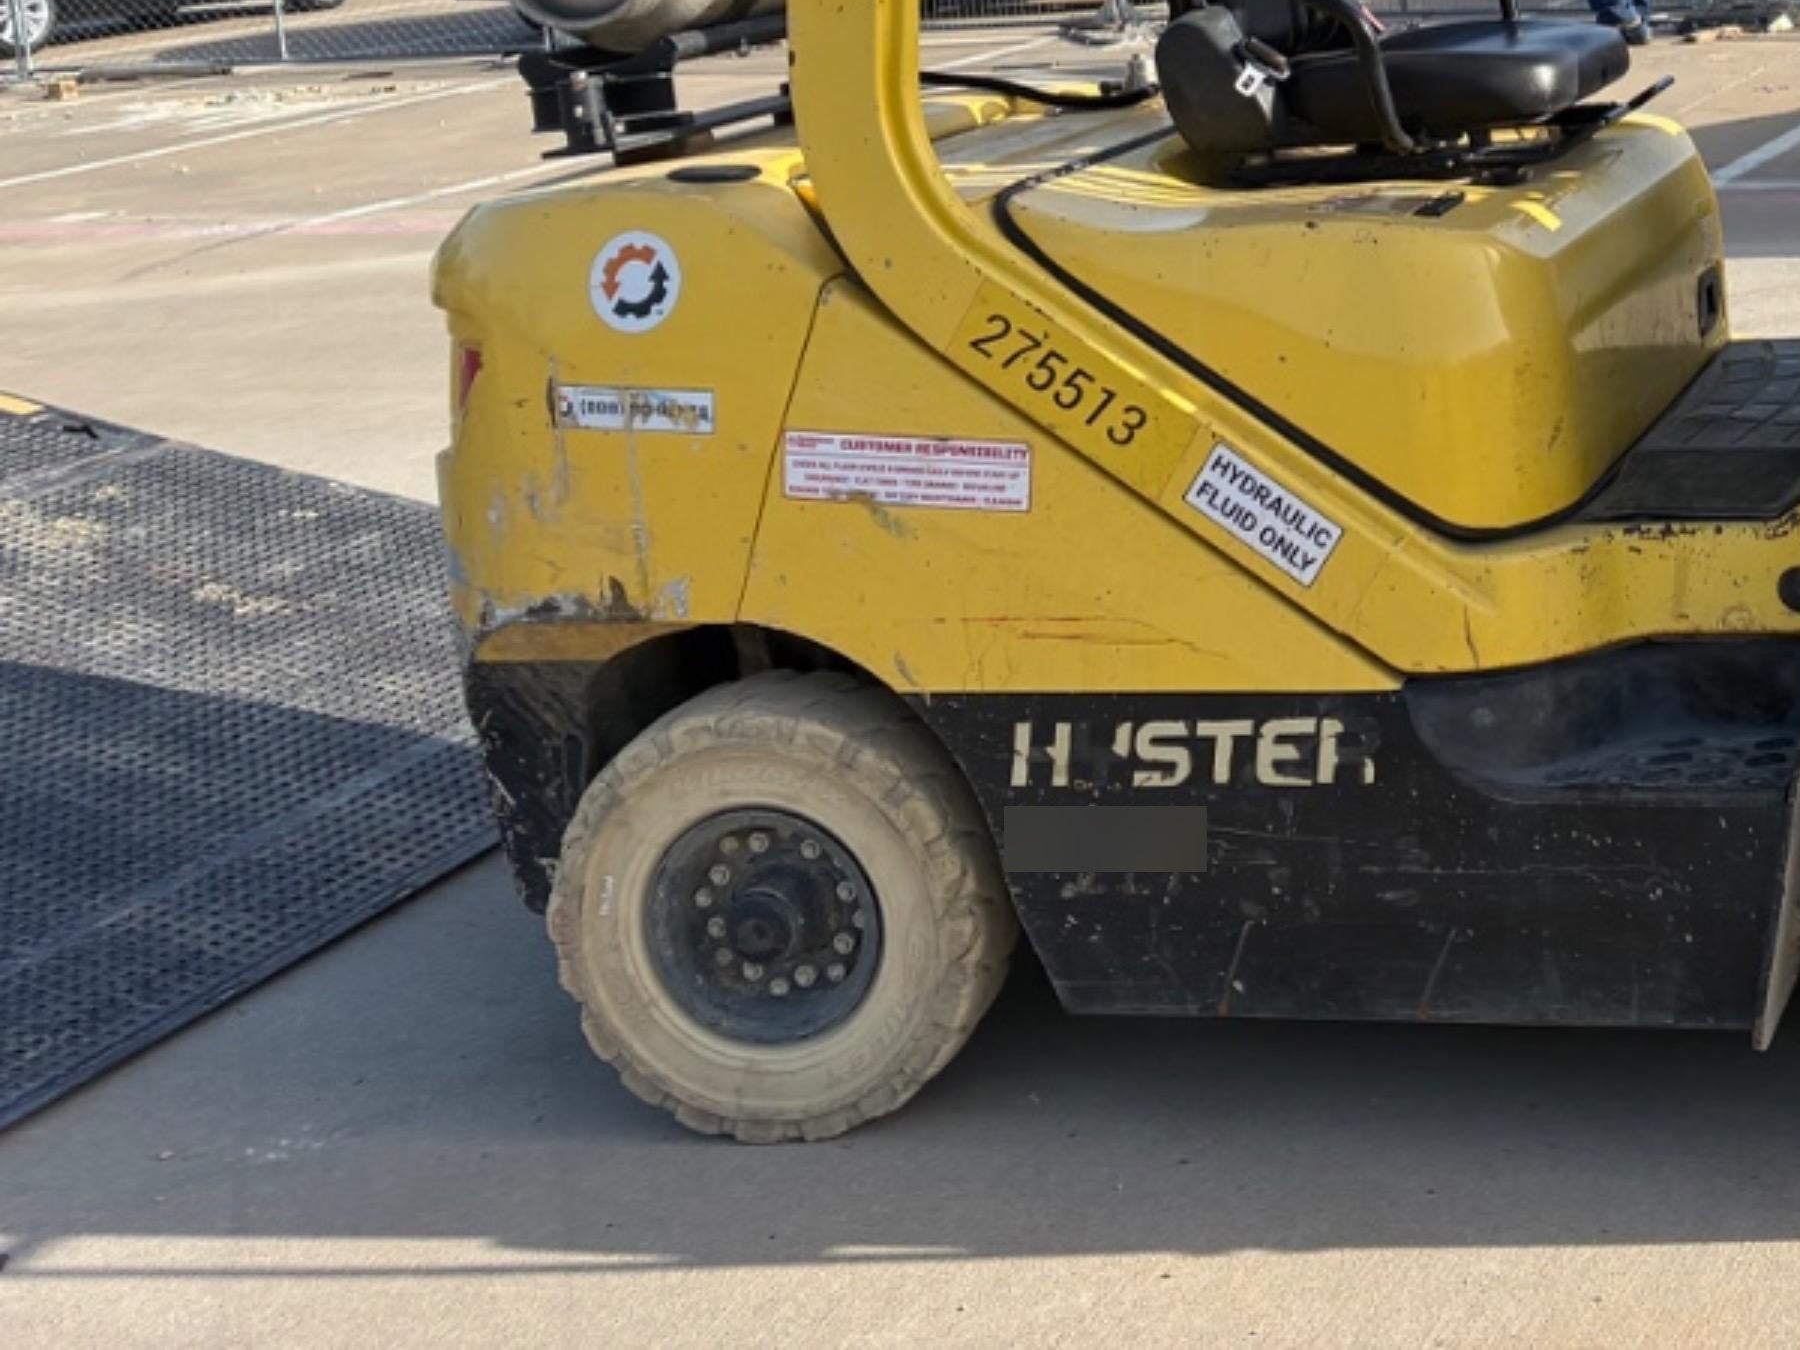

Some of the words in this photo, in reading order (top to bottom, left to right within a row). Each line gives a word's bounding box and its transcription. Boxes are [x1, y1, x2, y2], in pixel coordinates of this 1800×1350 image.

[968, 312, 1149, 446] 275513
[839, 437, 913, 454] CUSTOMER
[1195, 480, 1259, 533] FLUID
[1258, 524, 1318, 573] ONLY
[1211, 455, 1333, 550] HYDRAULIC
[1010, 716, 1377, 788] HSTER
